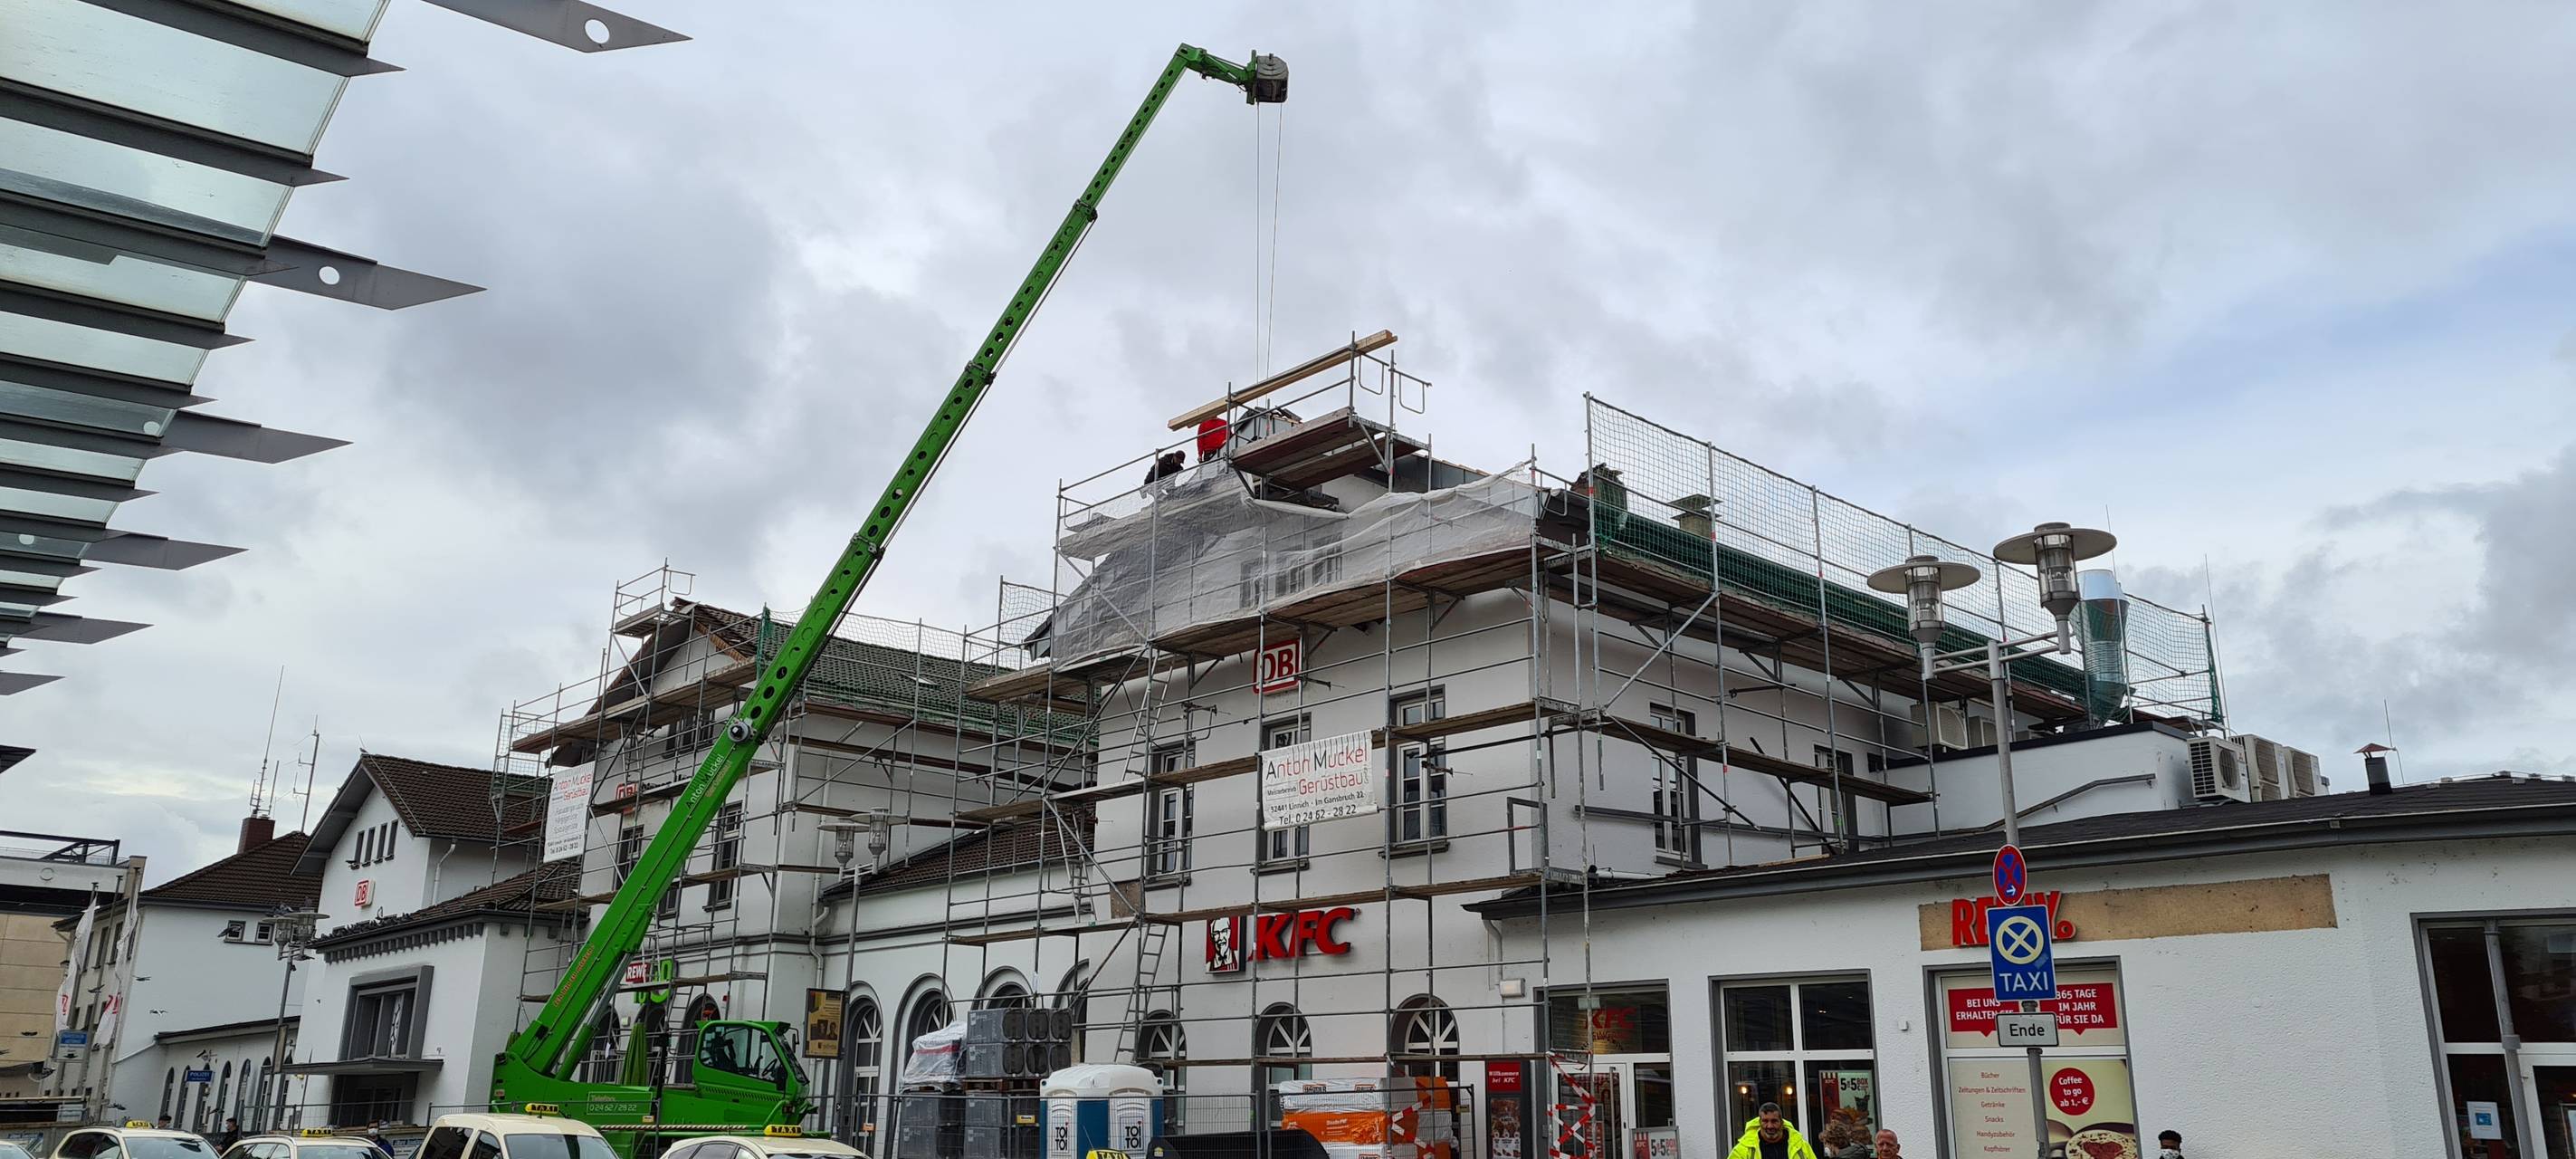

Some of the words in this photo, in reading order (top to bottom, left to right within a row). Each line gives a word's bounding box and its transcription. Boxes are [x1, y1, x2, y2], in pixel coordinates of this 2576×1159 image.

[1258, 646, 1296, 684] DB
[1266, 758, 1311, 780] Anton
[1314, 745, 1367, 771] Muckel
[1299, 771, 1363, 795] Gerüstbau
[685, 782, 706, 809] Anton
[1289, 800, 1309, 810] Linnich
[1279, 815, 1293, 825] Tel.
[1295, 813, 1301, 823] 0
[1303, 811, 1312, 822] 24
[1315, 809, 1325, 819] 62
[1333, 806, 1343, 817] 28
[1346, 804, 1357, 815] 22
[1247, 906, 1355, 962] KFC
[626, 964, 648, 980] REWE
[1999, 972, 2049, 992] TAXI
[2056, 991, 2073, 1000] 365
[2075, 989, 2097, 998] TAGE
[1967, 999, 1982, 1008] BEI
[1983, 999, 2000, 1008] UNS
[2058, 1002, 2071, 1011] IM
[2072, 1001, 2096, 1011] JAHR
[1585, 1007, 1637, 1030] KFC
[1955, 1011, 1997, 1020] ERHALTEN
[2074, 1014, 2089, 1023] SIE
[2091, 1014, 2104, 1023] DA
[2009, 1023, 2046, 1037] Ende
[2058, 1077, 2083, 1086] Coffee
[1055, 1139, 1068, 1151] TOI
[1125, 1137, 1141, 1149] TOI
